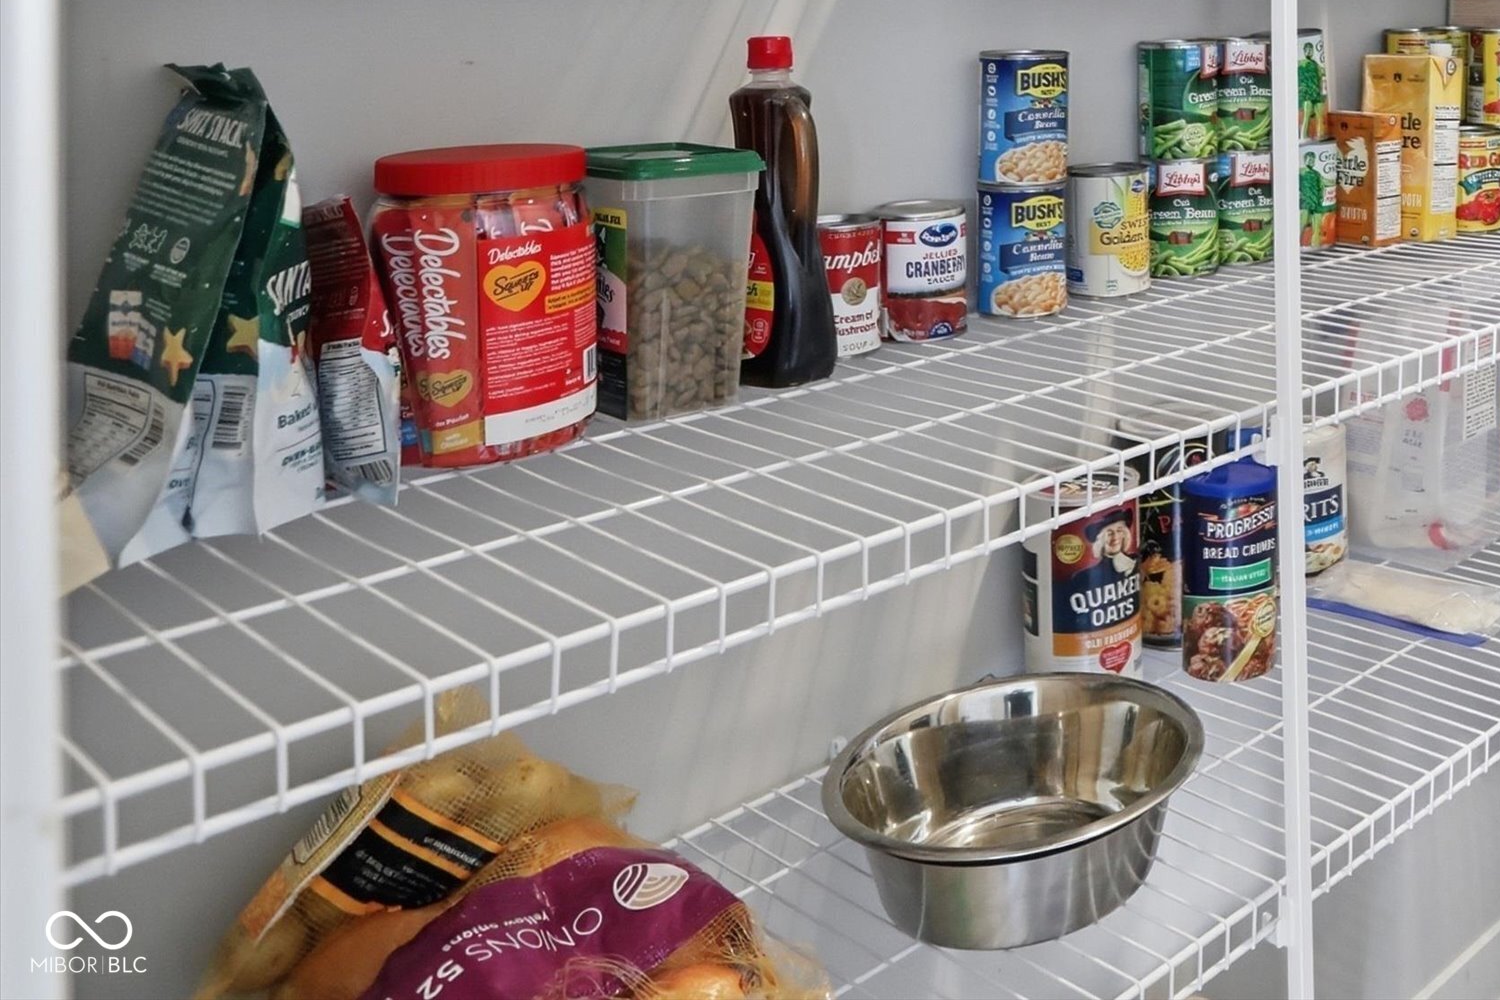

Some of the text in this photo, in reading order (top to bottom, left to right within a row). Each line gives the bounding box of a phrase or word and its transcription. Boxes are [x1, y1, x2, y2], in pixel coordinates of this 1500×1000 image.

[1218, 87, 1246, 96] reen
[1401, 113, 1422, 131] tle
[1402, 135, 1421, 149] re
[1336, 155, 1367, 171] ettle
[1458, 154, 1487, 169] RED
[488, 240, 542, 265] Delectables
[414, 228, 466, 360] Delectables
[1304, 494, 1339, 522] RITS
[1207, 505, 1276, 539] PROGRESS
[1203, 546, 1240, 560] BREAD
[1092, 598, 1135, 626] OATS
[442, 910, 551, 953] Yellow onions
[465, 907, 603, 962] ONIONS
